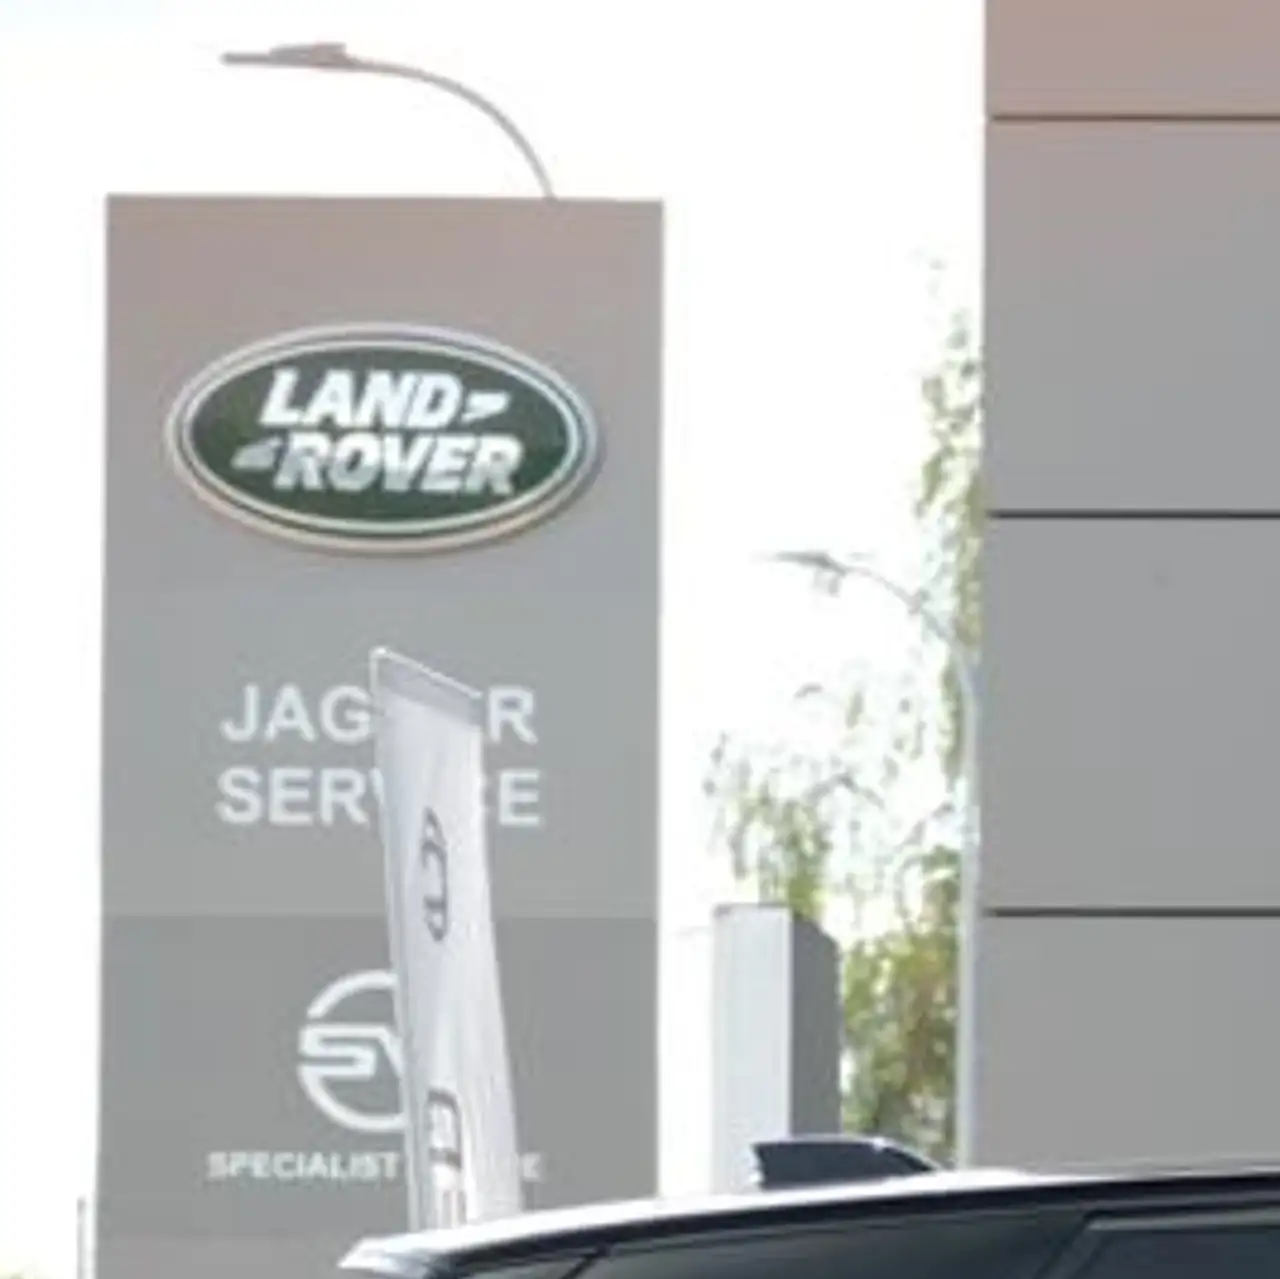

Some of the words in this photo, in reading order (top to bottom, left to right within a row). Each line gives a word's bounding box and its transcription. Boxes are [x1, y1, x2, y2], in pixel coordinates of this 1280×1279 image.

[259, 368, 463, 427] LAND
[273, 431, 524, 495] ROVER
[219, 684, 538, 745] JAGR
[214, 765, 542, 827] SERE
[207, 1151, 400, 1181] SPECIALIST
